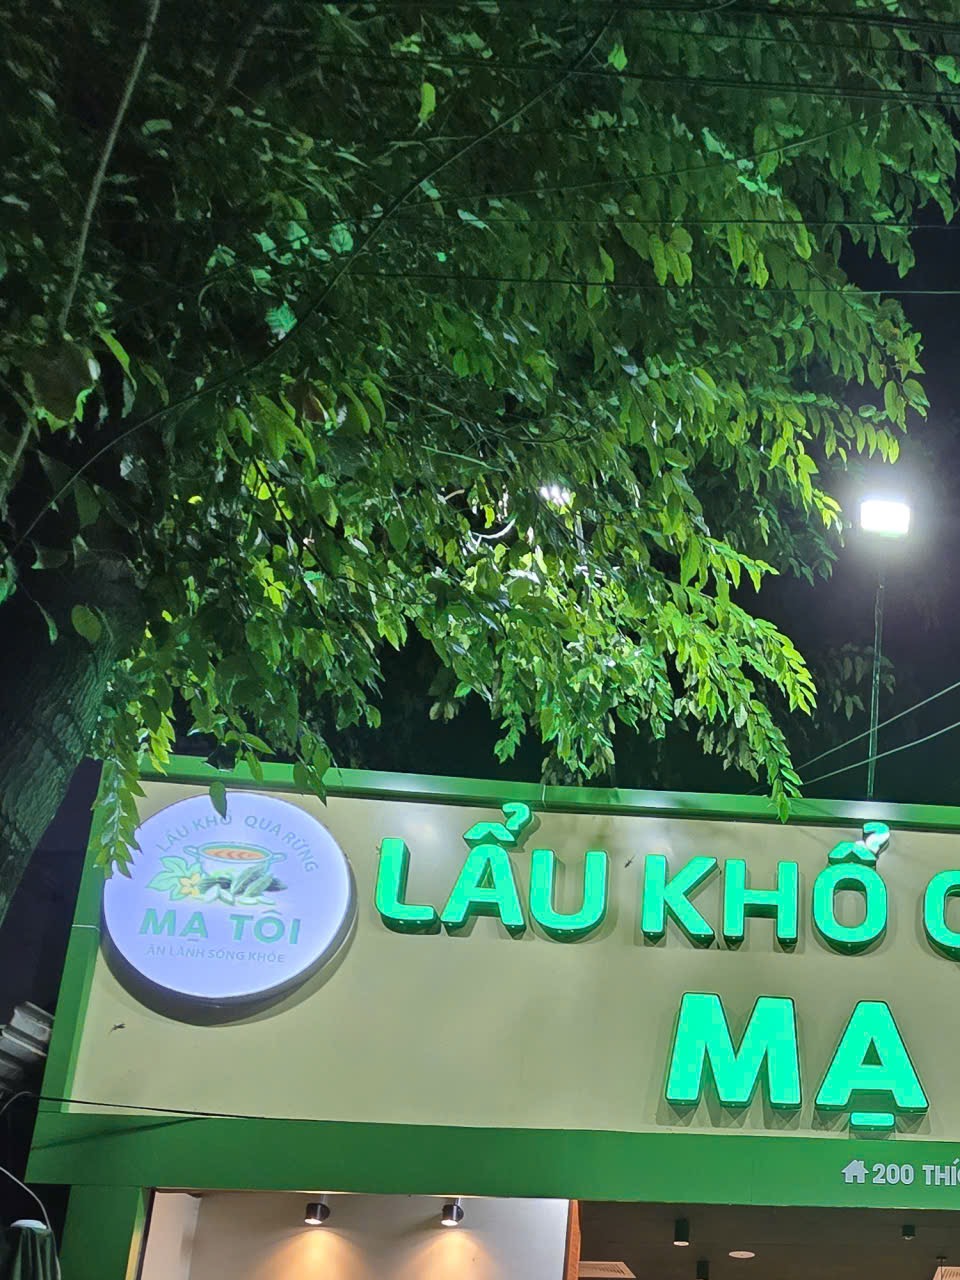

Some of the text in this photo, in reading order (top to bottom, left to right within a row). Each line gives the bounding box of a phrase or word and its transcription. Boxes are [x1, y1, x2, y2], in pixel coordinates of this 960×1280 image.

[244, 815, 281, 837] QUA
[375, 802, 607, 936] LẨU
[641, 822, 890, 947] KHỔ
[138, 908, 301, 945] MẠ TÔI
[665, 991, 930, 1130] MẠ
[872, 1163, 915, 1185] 200
